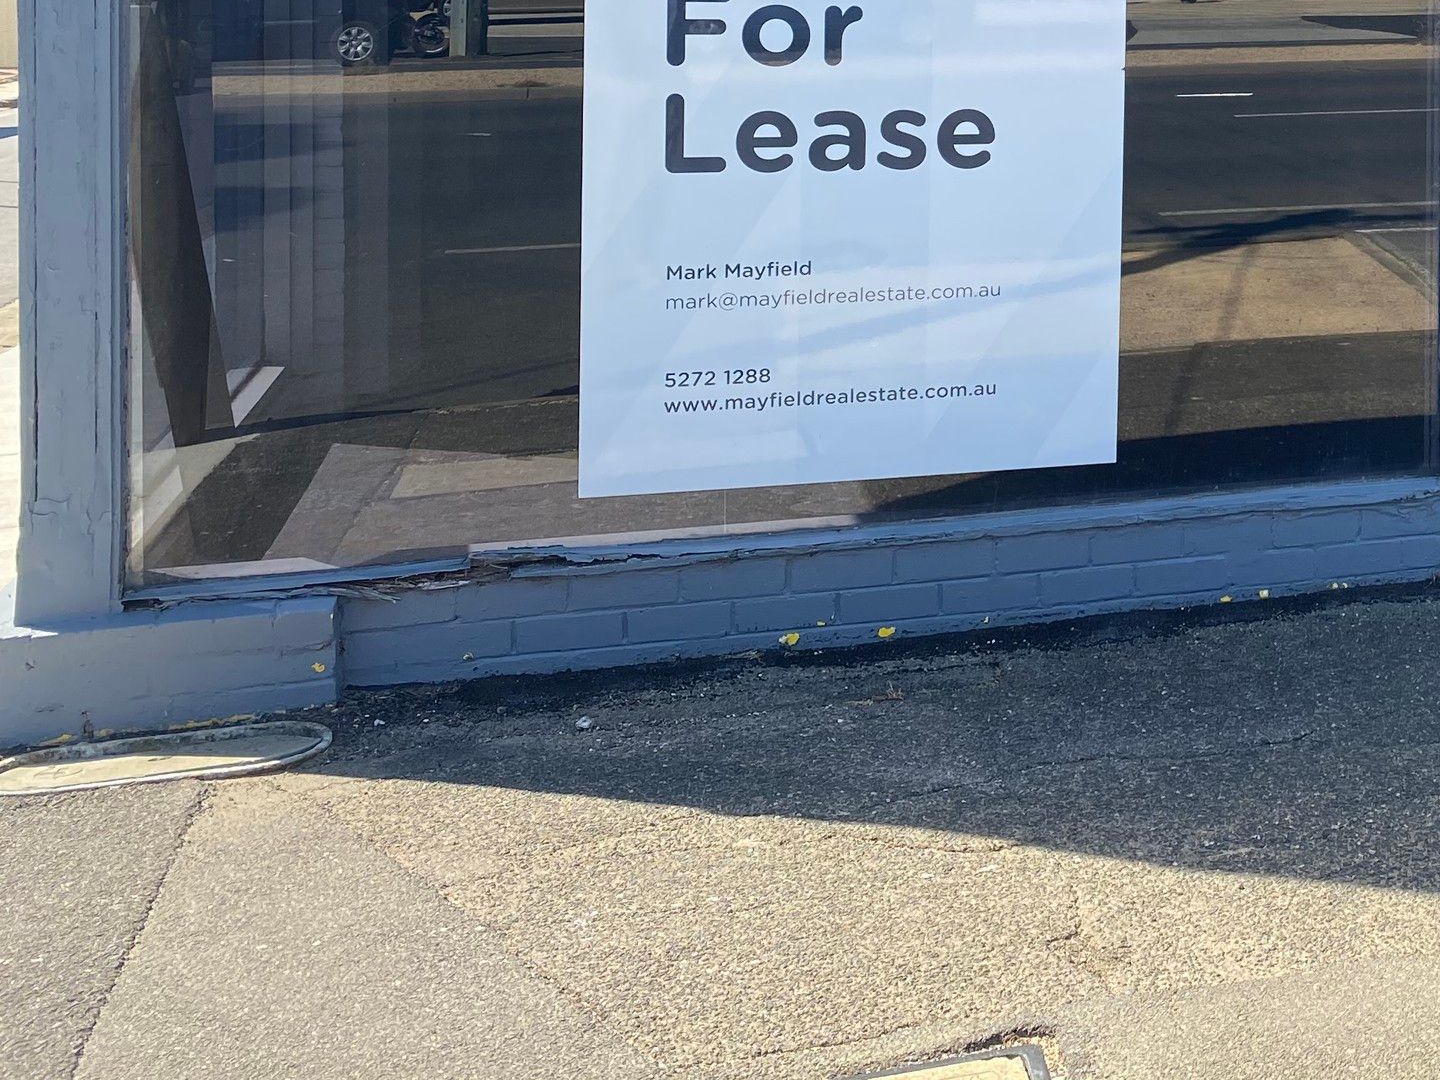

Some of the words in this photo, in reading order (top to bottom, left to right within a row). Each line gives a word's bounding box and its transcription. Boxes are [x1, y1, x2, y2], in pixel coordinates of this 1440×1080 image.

[665, 94, 996, 174] Lease
[665, 263, 717, 281] Mark
[725, 260, 813, 281] Mayfield
[665, 283, 1002, 311] mark@mayfieldrealestate.com.au
[664, 370, 716, 388] 5272
[724, 368, 771, 385] 1288
[664, 383, 997, 414] www.mayfieldrealestate.com.au
